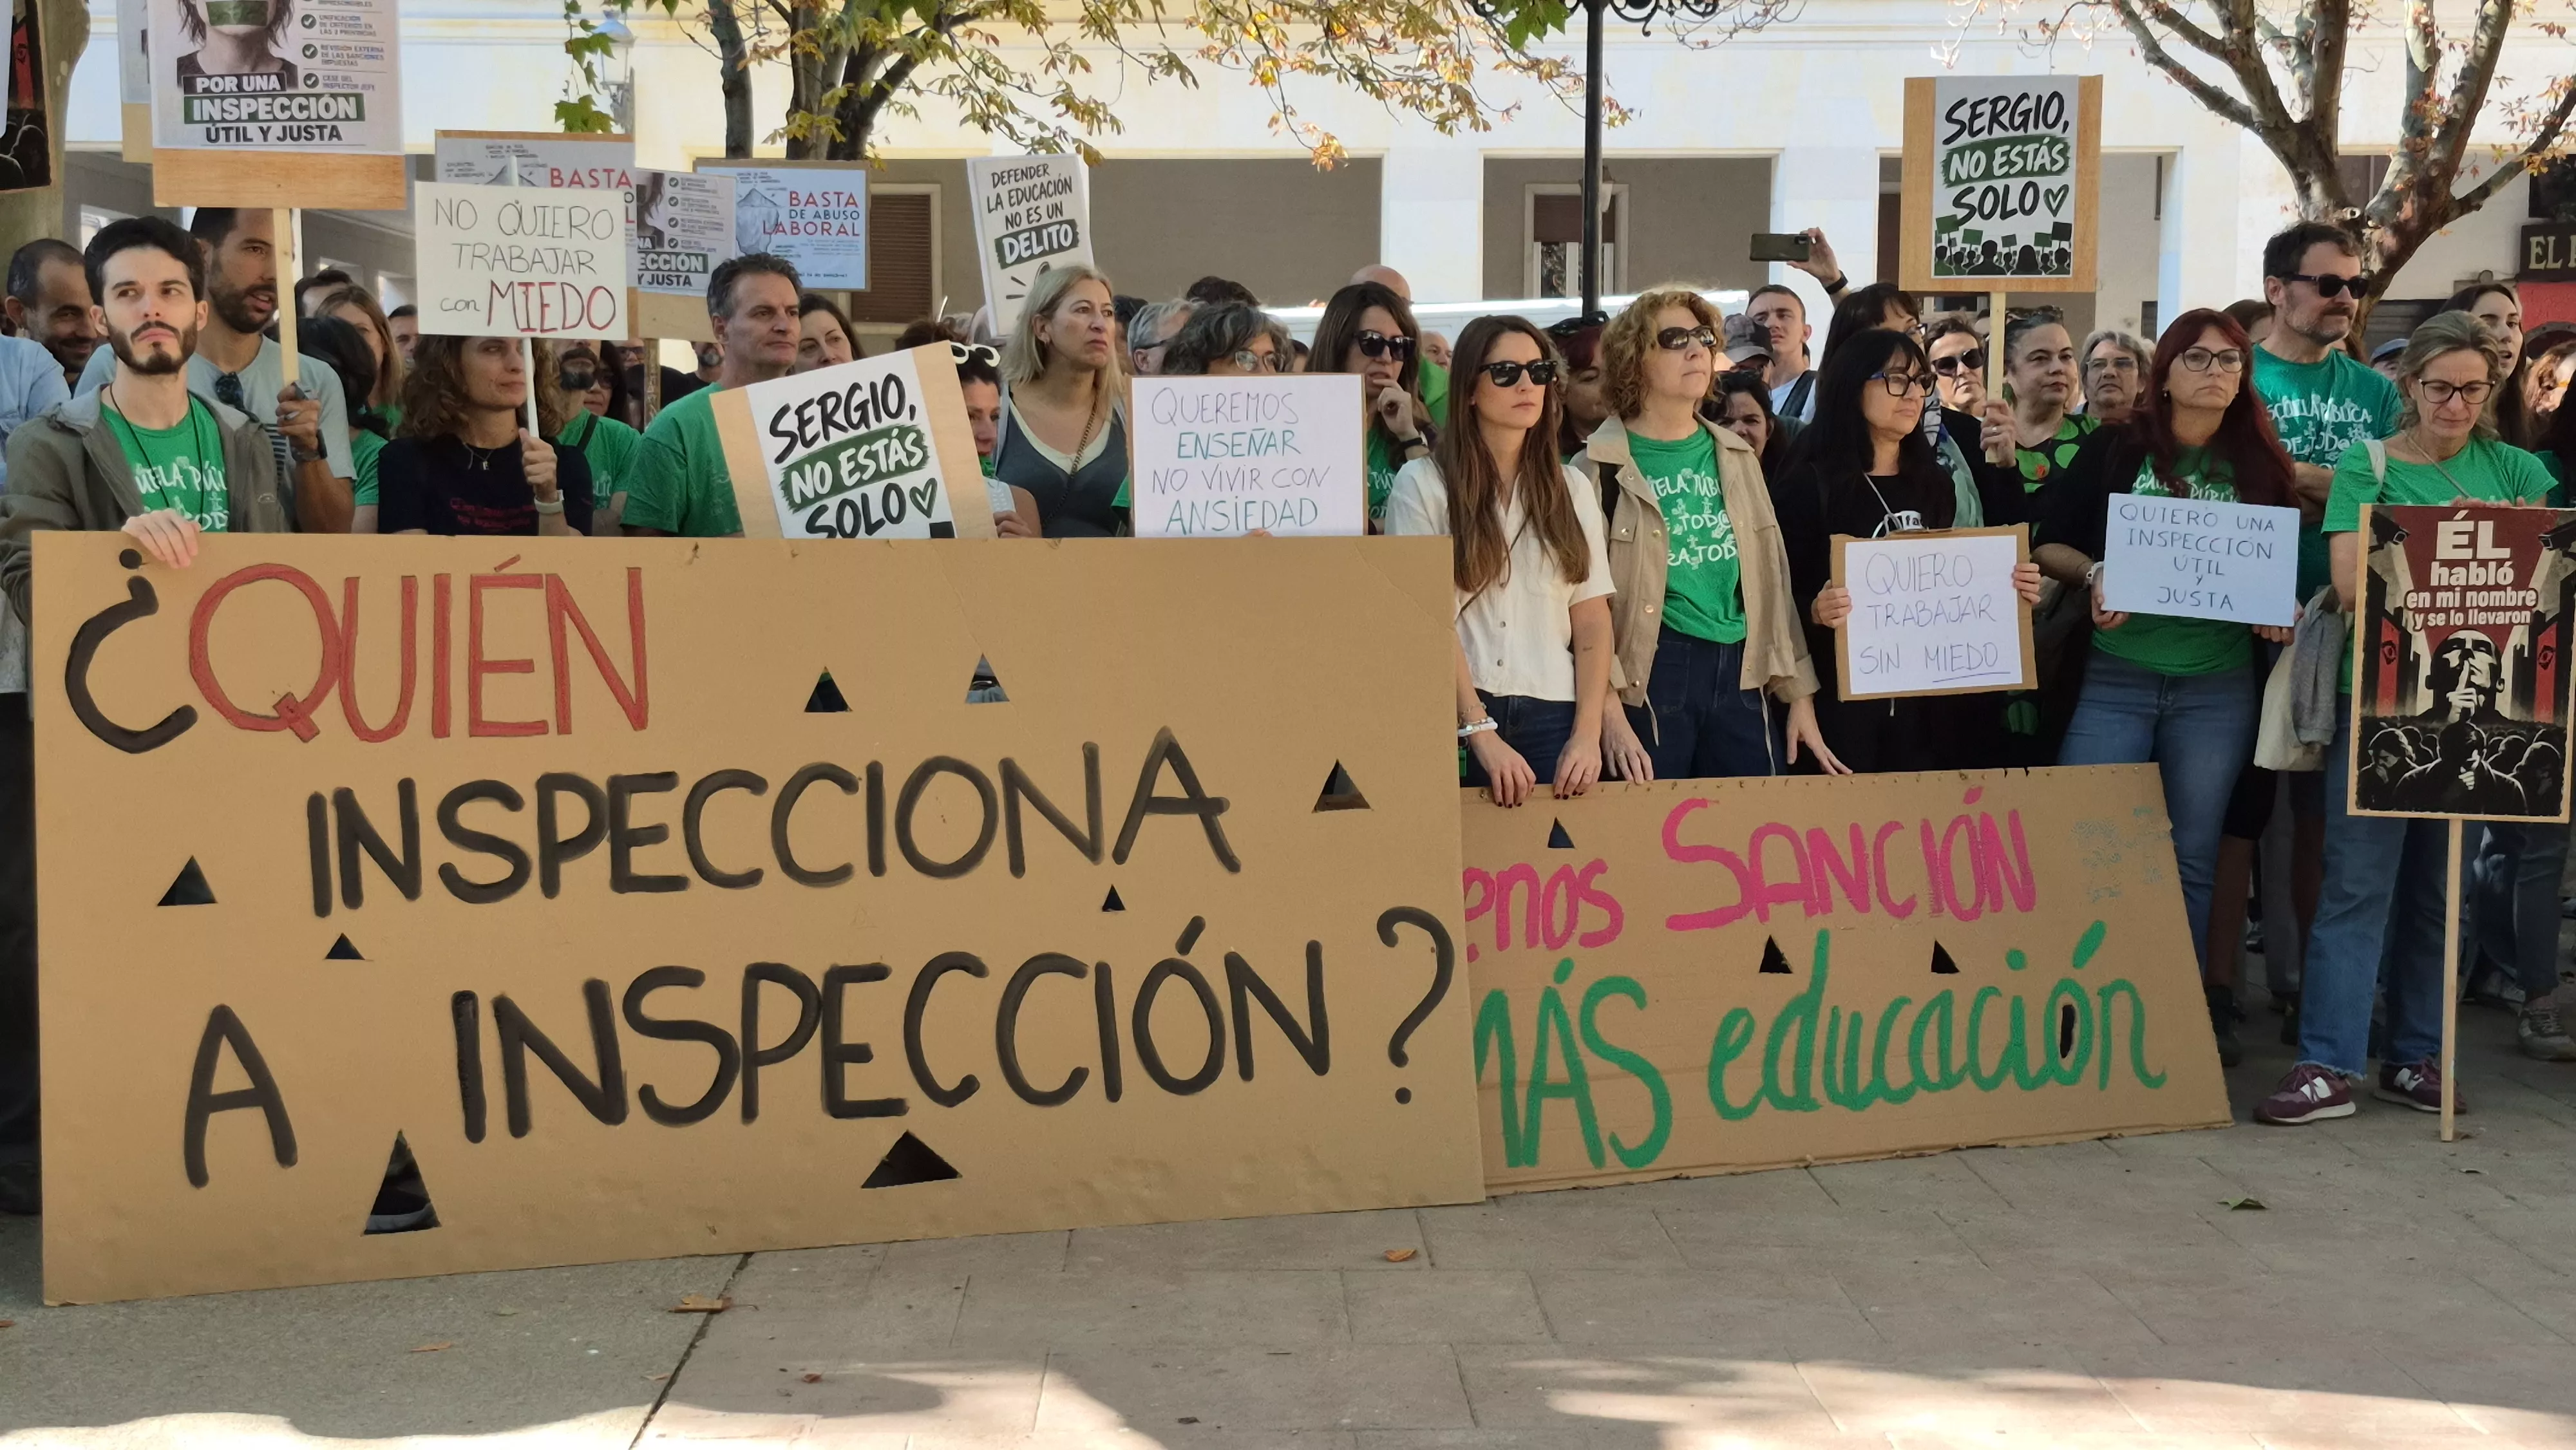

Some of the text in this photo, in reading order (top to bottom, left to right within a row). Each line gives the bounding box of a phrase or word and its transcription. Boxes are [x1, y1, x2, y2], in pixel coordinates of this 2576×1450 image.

[196, 75, 281, 93] POR UNA
[193, 93, 357, 121] INSPECCIÓN
[1942, 91, 2069, 145] SERGIO,
[205, 124, 343, 144] ÚTIL Y JUSTA
[1949, 137, 2065, 182] NO ESTÁS
[550, 167, 632, 188] BASTA
[991, 164, 1050, 189] DEFENDER
[790, 191, 858, 208] BASTA
[987, 173, 1072, 214] LA EDUCACIÓN
[1952, 181, 2040, 227] SOLO
[436, 198, 477, 231] NO
[498, 202, 614, 240] QUIERO
[762, 220, 860, 237] LABORAL
[790, 209, 860, 220] DE ABUSO
[1005, 201, 1063, 231] NO ES UN
[452, 243, 597, 275] TRABAJAR
[1003, 223, 1073, 263] DELITO
[2529, 235, 2562, 269] EL
[647, 274, 692, 287] JUSTA
[440, 279, 616, 333] con MIEDO
[770, 373, 916, 464] SERGIO,
[1152, 387, 1299, 426] QUEREMOS
[1177, 428, 1301, 460] ENSEÑAR
[791, 428, 924, 504] NO ESTÁS
[1153, 468, 1188, 494] NO
[1272, 466, 1331, 488] CON
[806, 482, 907, 538] SOLO
[2119, 503, 2274, 532] QUIERO UNA
[2436, 509, 2511, 559] ÉL
[1866, 552, 1972, 595] QUIERO
[2430, 561, 2514, 586] habló
[1867, 594, 1996, 630] TRABAJAR
[2157, 587, 2233, 611] JUSTA
[2406, 587, 2537, 608] en mi nombre
[2415, 608, 2531, 630] y se lo llevaron
[64, 549, 649, 753] ¿QUIÉN
[1859, 642, 1998, 674] SIN MIEDO
[307, 725, 1240, 916] INSPECCIONA
[1473, 919, 2166, 1169] MÁS educación
[183, 1004, 298, 1189] A
